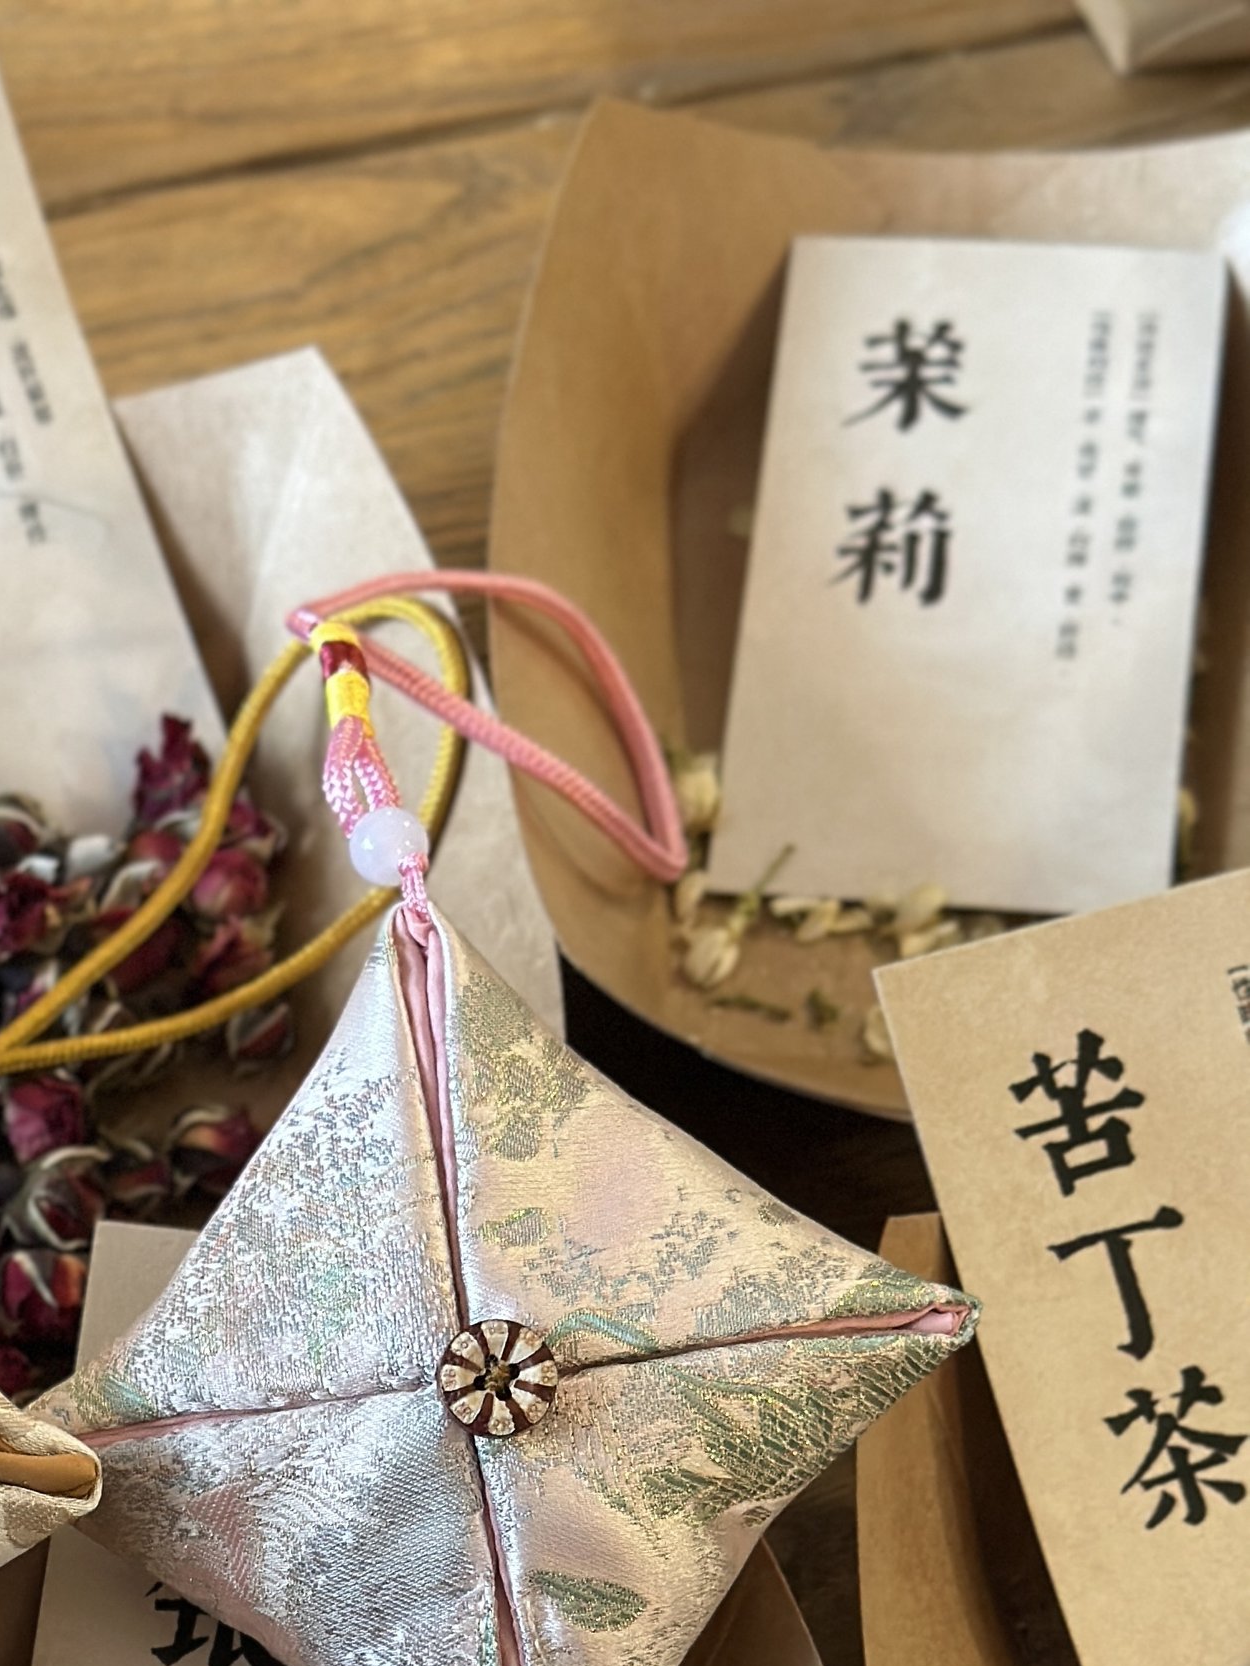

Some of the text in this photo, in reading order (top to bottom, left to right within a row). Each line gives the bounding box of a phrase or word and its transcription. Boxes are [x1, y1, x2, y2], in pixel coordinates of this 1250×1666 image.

[832, 318, 970, 606] 茉莉
[1009, 1028, 1248, 1530] 苦丁茶
